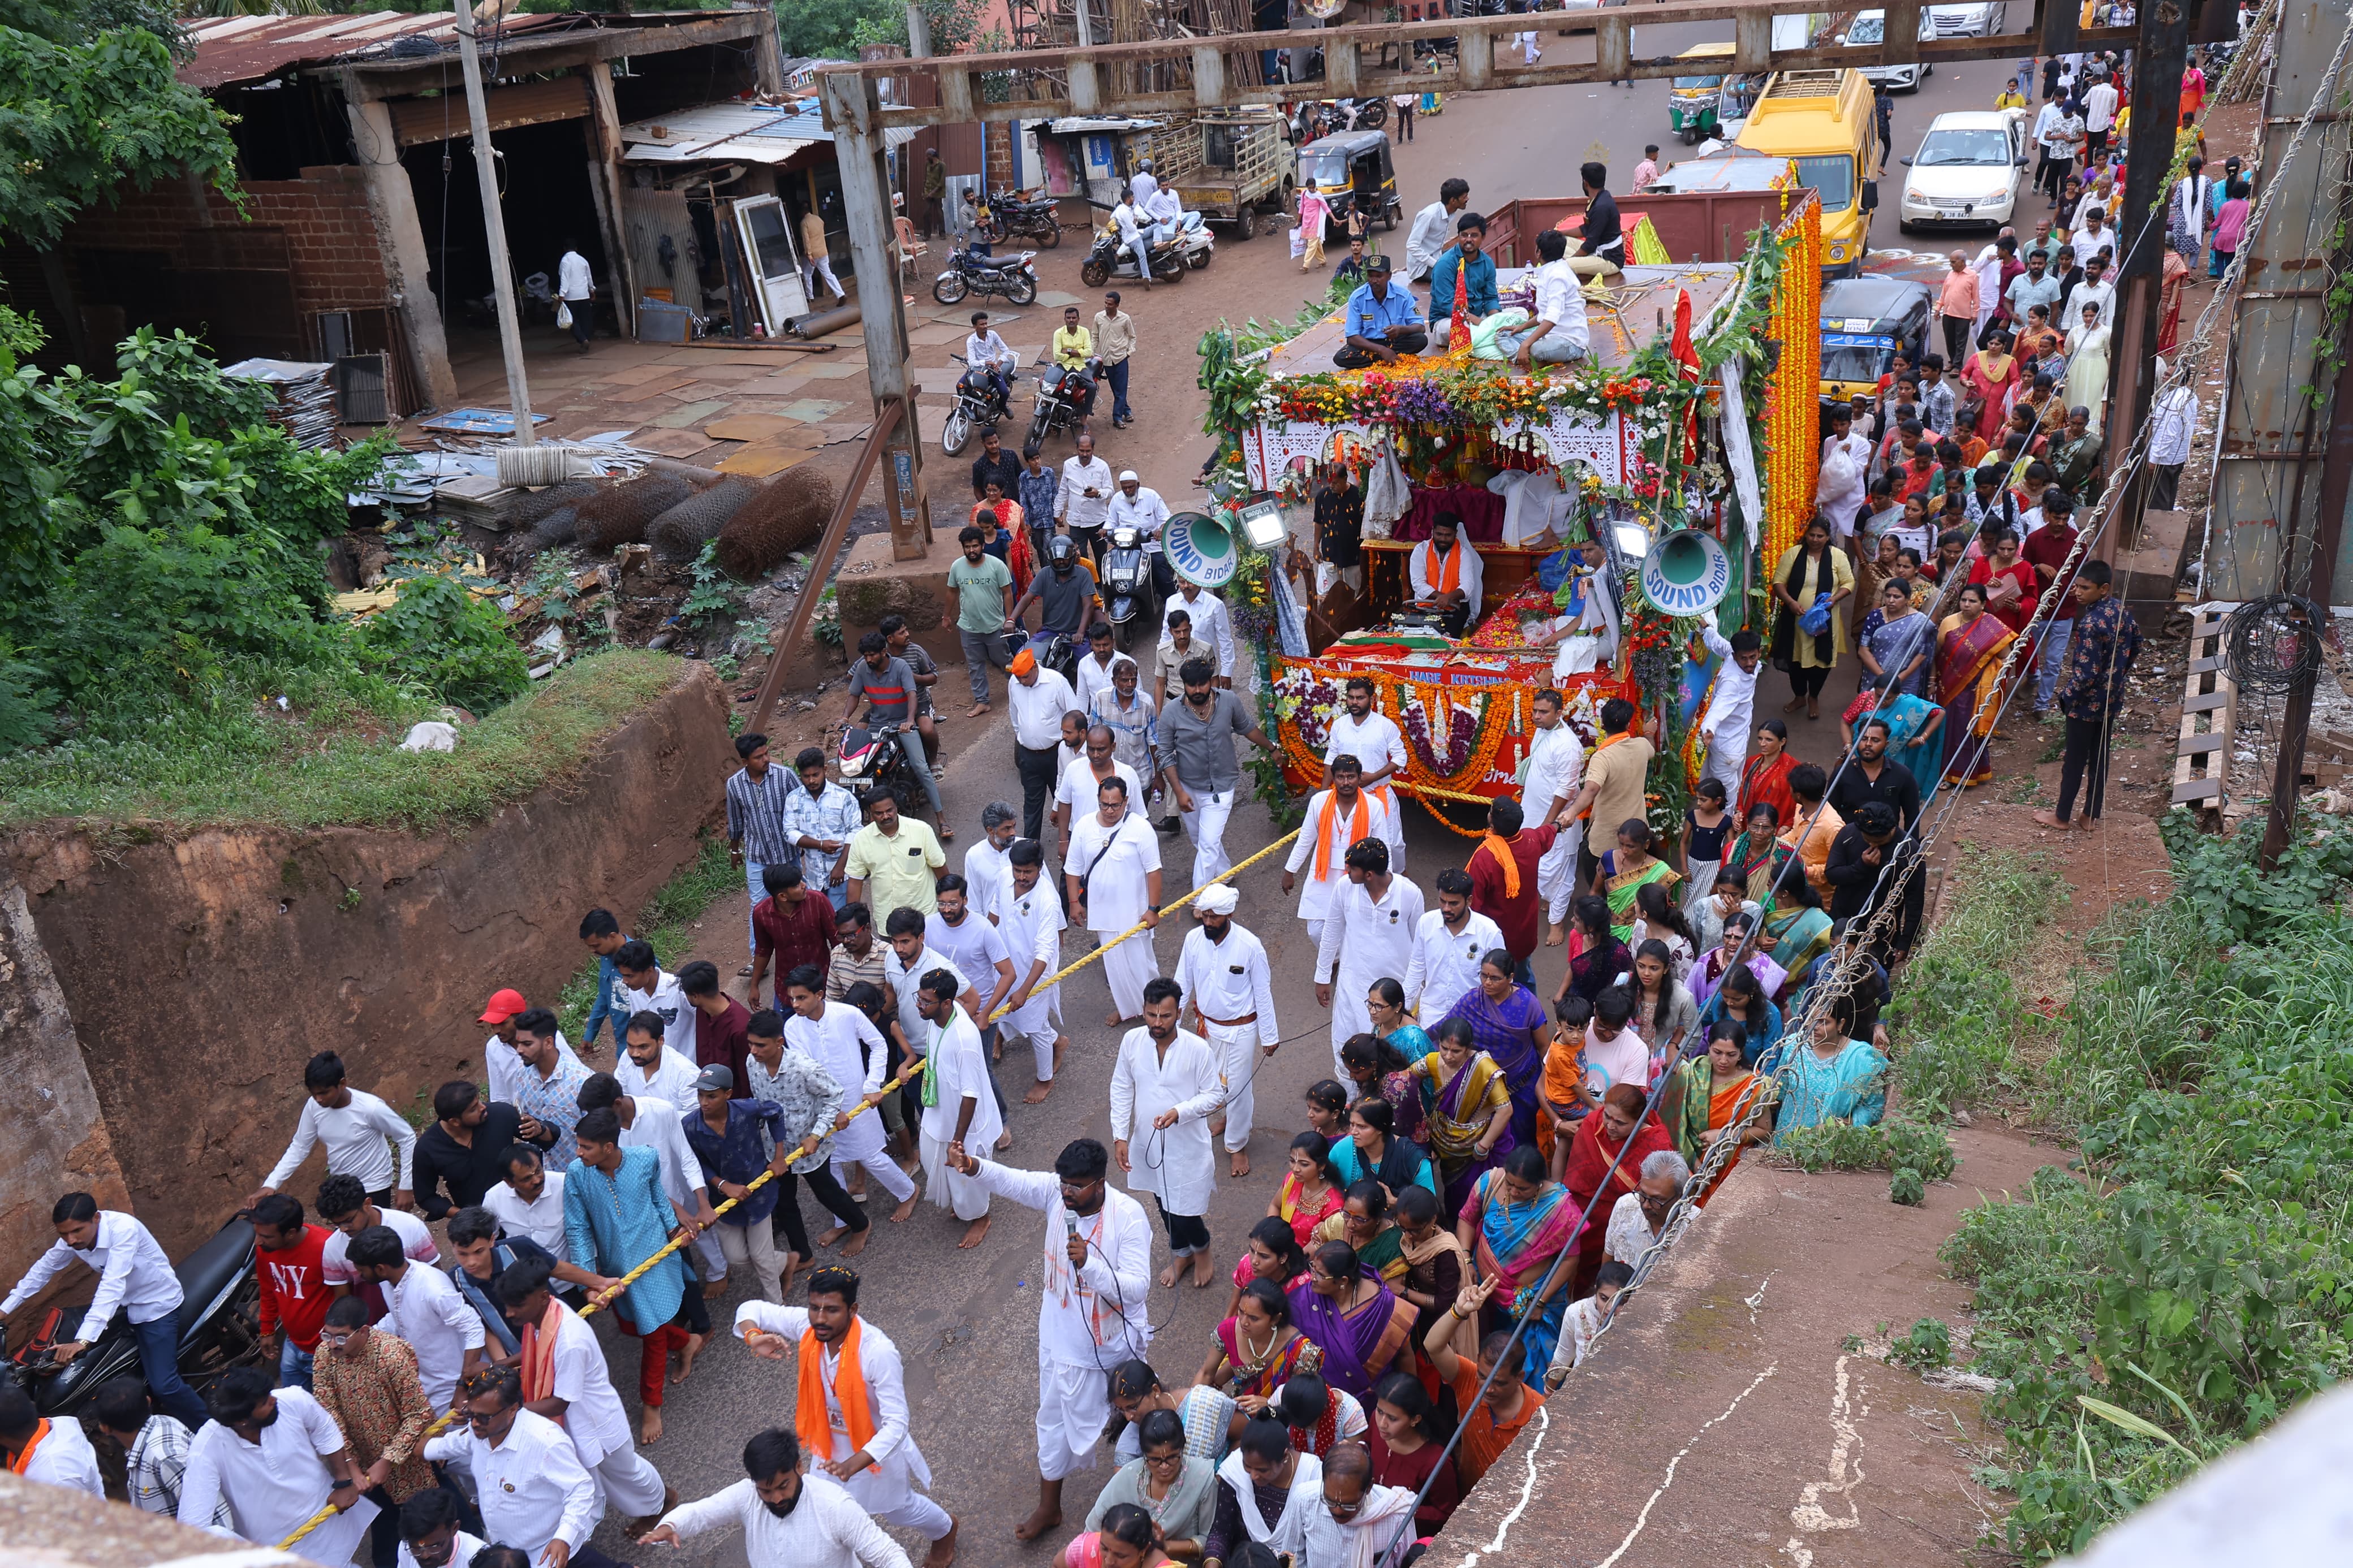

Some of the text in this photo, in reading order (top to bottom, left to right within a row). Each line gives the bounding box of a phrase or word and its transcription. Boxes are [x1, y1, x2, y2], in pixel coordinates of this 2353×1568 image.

[1245, 508, 1263, 519] SOUND
[1170, 519, 1203, 573] SOUND
[1647, 568, 1707, 608] SOUND
[1408, 671, 1442, 684] HARE
[269, 1262, 308, 1299] NY
[64, 1366, 85, 1385] HONDA
